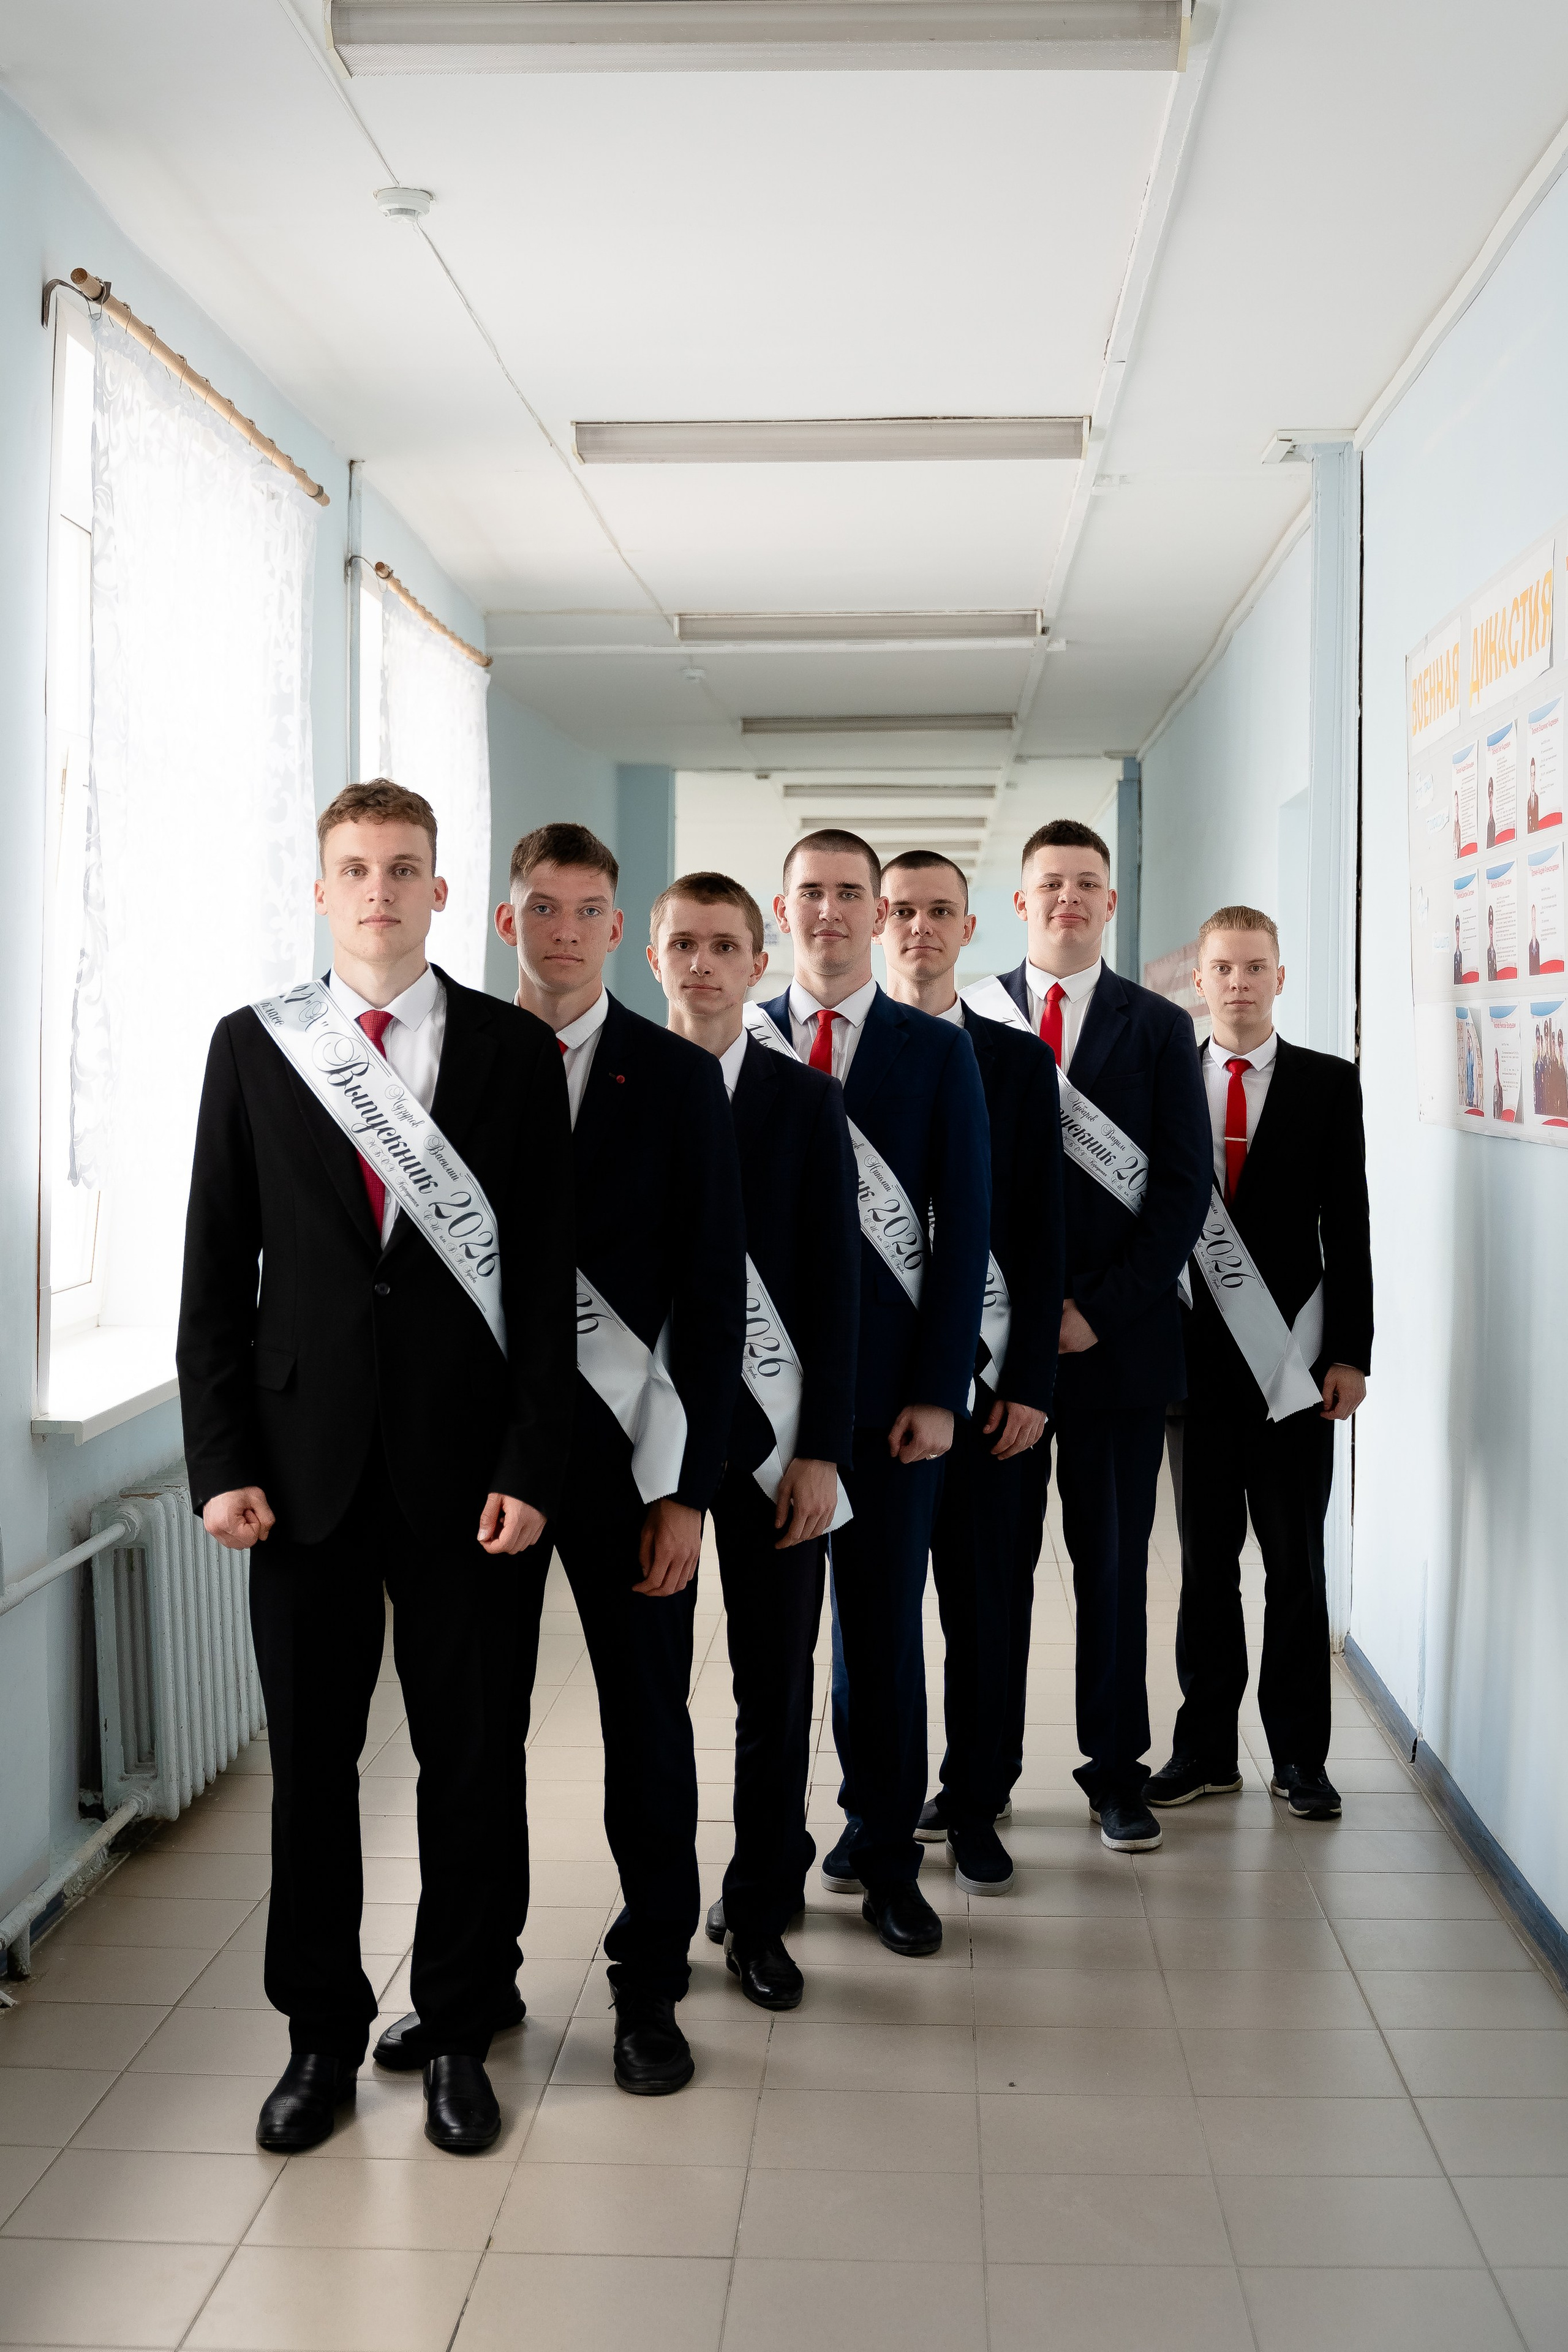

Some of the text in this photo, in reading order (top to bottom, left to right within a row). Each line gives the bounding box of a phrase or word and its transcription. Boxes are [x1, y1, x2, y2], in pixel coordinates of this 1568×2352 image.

[1412, 569, 1553, 737] ВОЕННАЯ ДИНАСТИЯ
[260, 1002, 285, 1027] класс
[1067, 1091, 1127, 1152] Чубаров Вадим
[311, 1031, 501, 1278] Выпускник 2026
[423, 1134, 464, 1183] Василий
[864, 1154, 895, 1193] Николай
[867, 1199, 924, 1270] 2026
